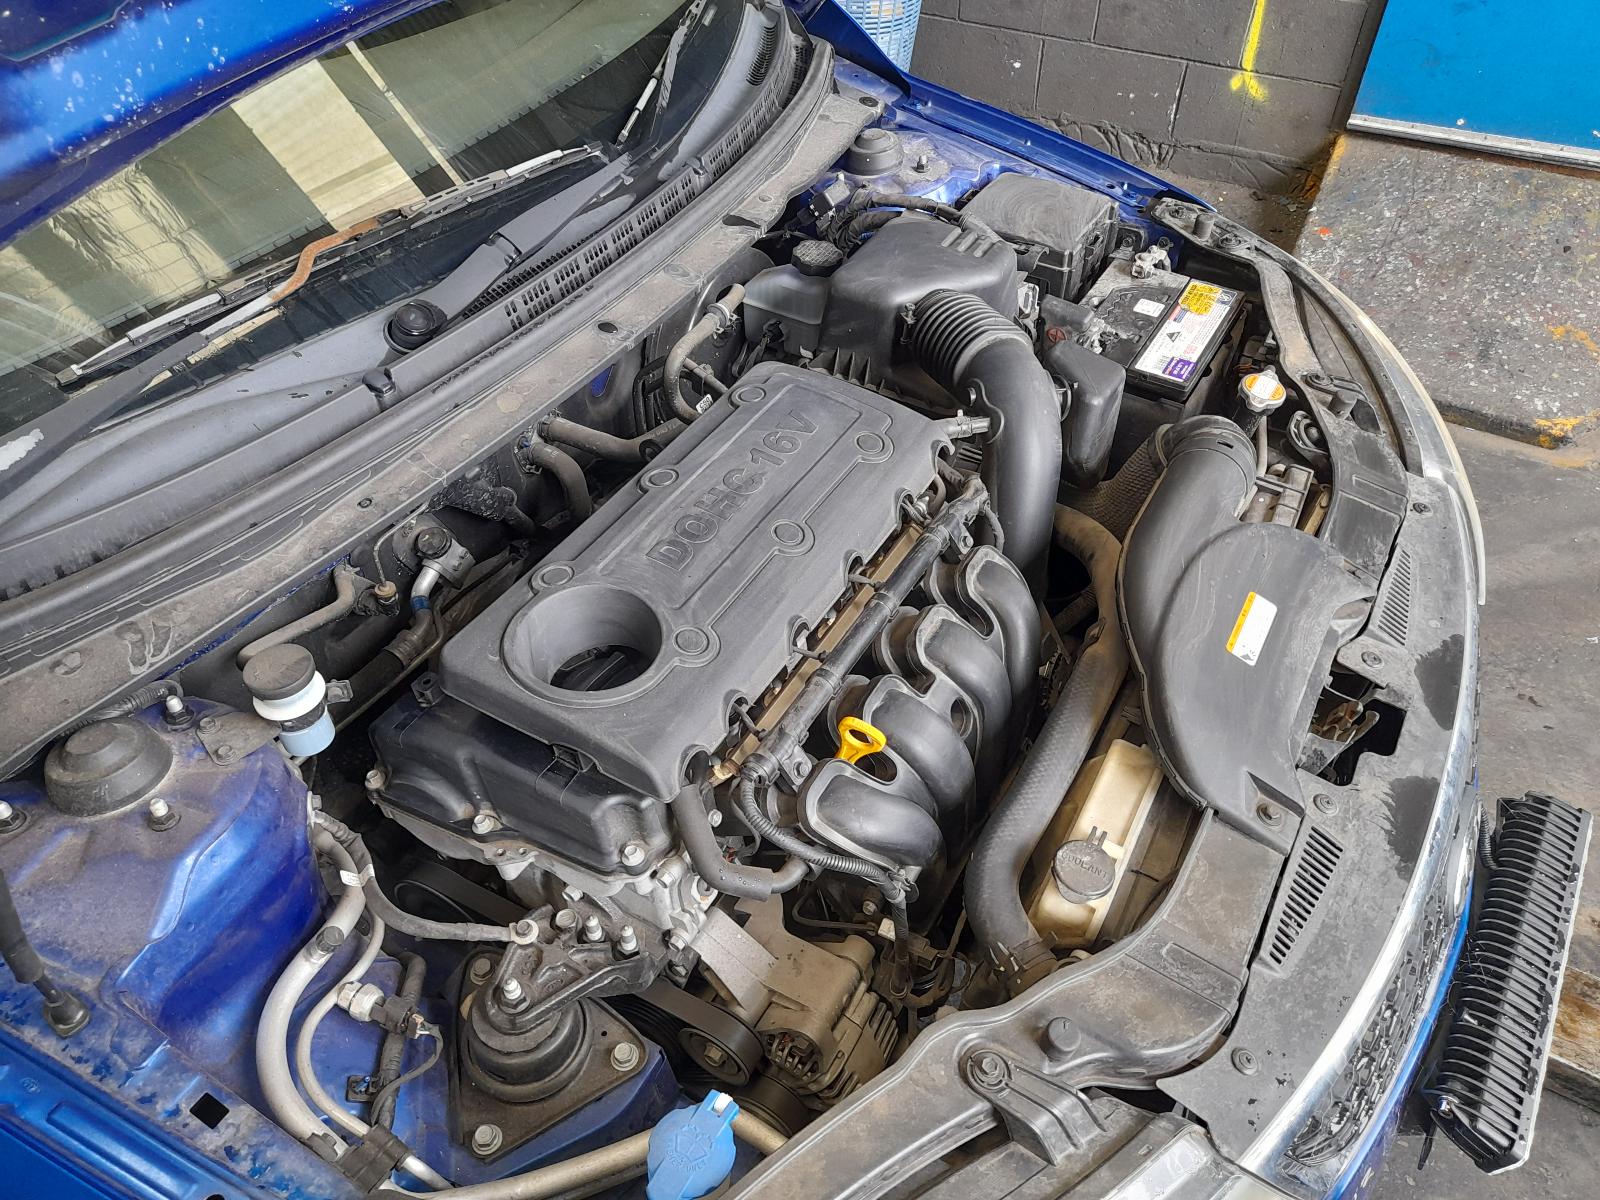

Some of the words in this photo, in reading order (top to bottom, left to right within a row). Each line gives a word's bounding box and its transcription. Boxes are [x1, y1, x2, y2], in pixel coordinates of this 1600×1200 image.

[644, 467, 767, 571] DOHC
[749, 409, 819, 466] 16V
[1062, 851, 1107, 878] COOLANT
